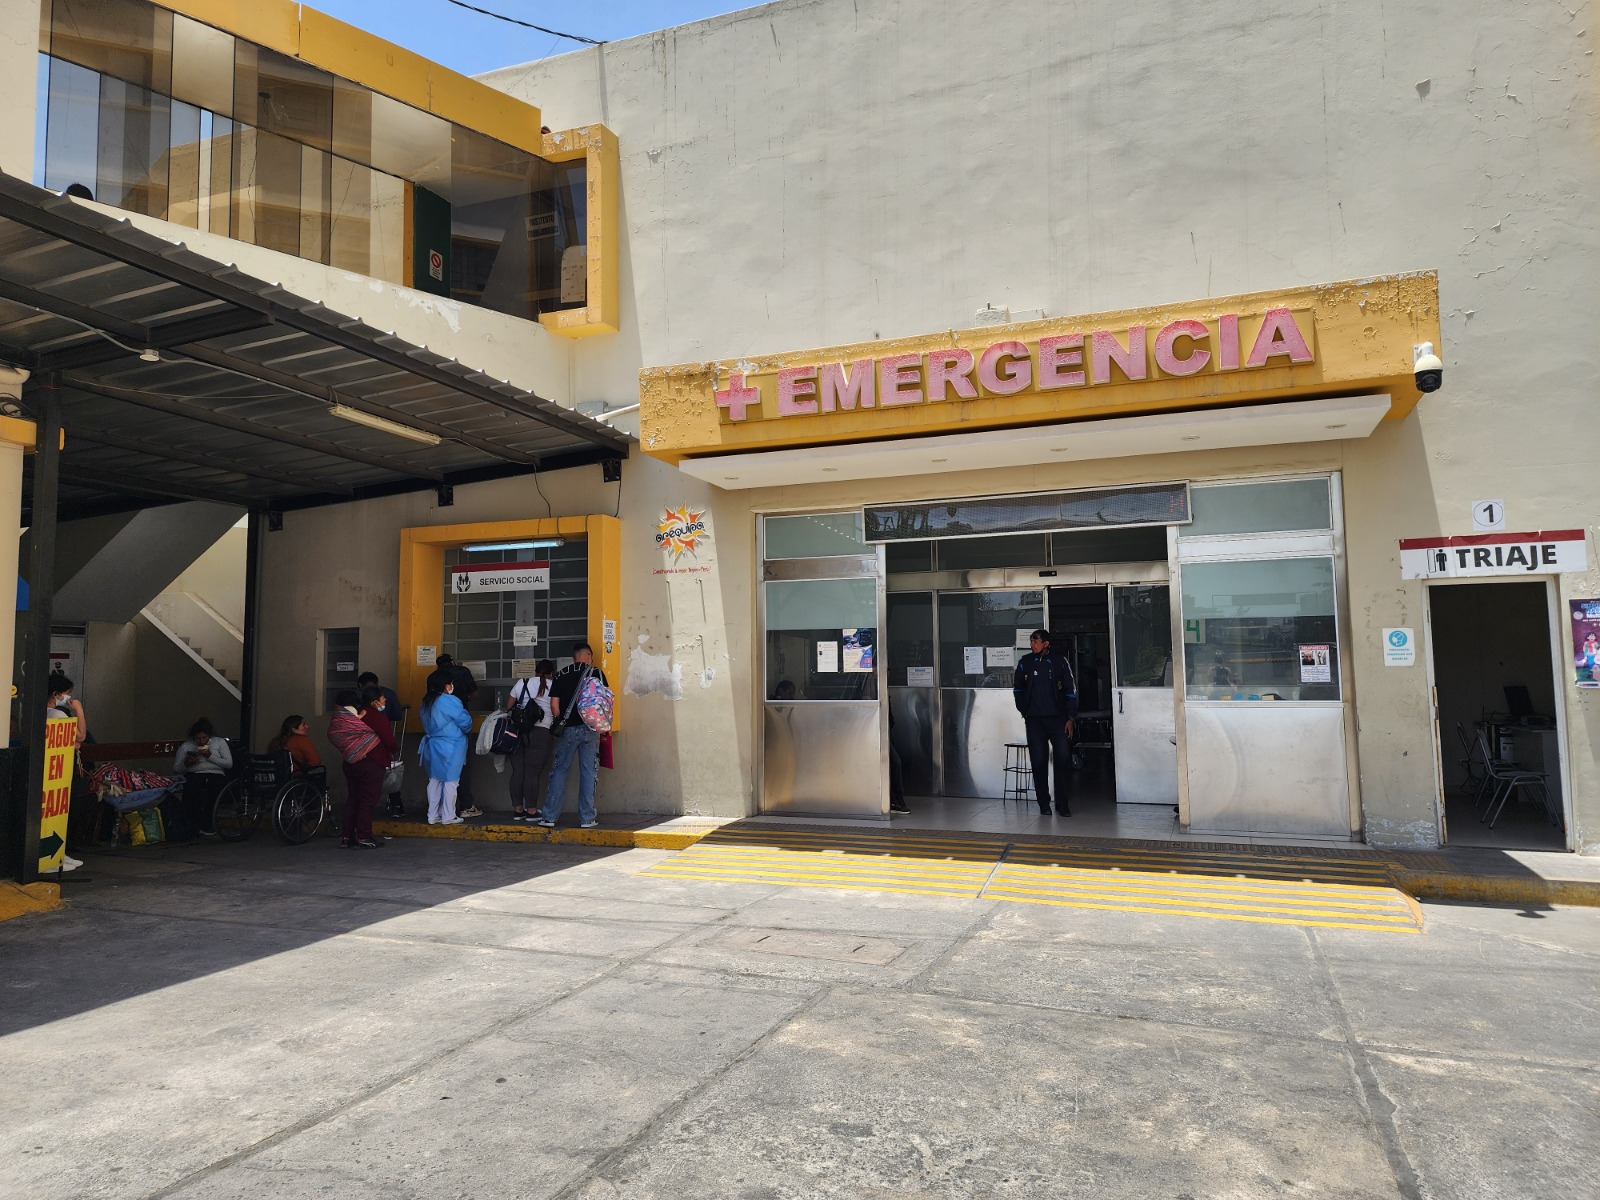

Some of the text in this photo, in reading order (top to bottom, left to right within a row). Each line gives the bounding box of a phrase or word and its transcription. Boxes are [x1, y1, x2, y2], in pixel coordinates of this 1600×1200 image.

[775, 306, 1315, 417] EMERGENCIA
[1483, 504, 1494, 523] 1
[1455, 544, 1558, 571] TRIAJE
[479, 575, 545, 587] SERVICIO SOCIAL
[1186, 619, 1201, 642] 4
[48, 754, 65, 781] EN
